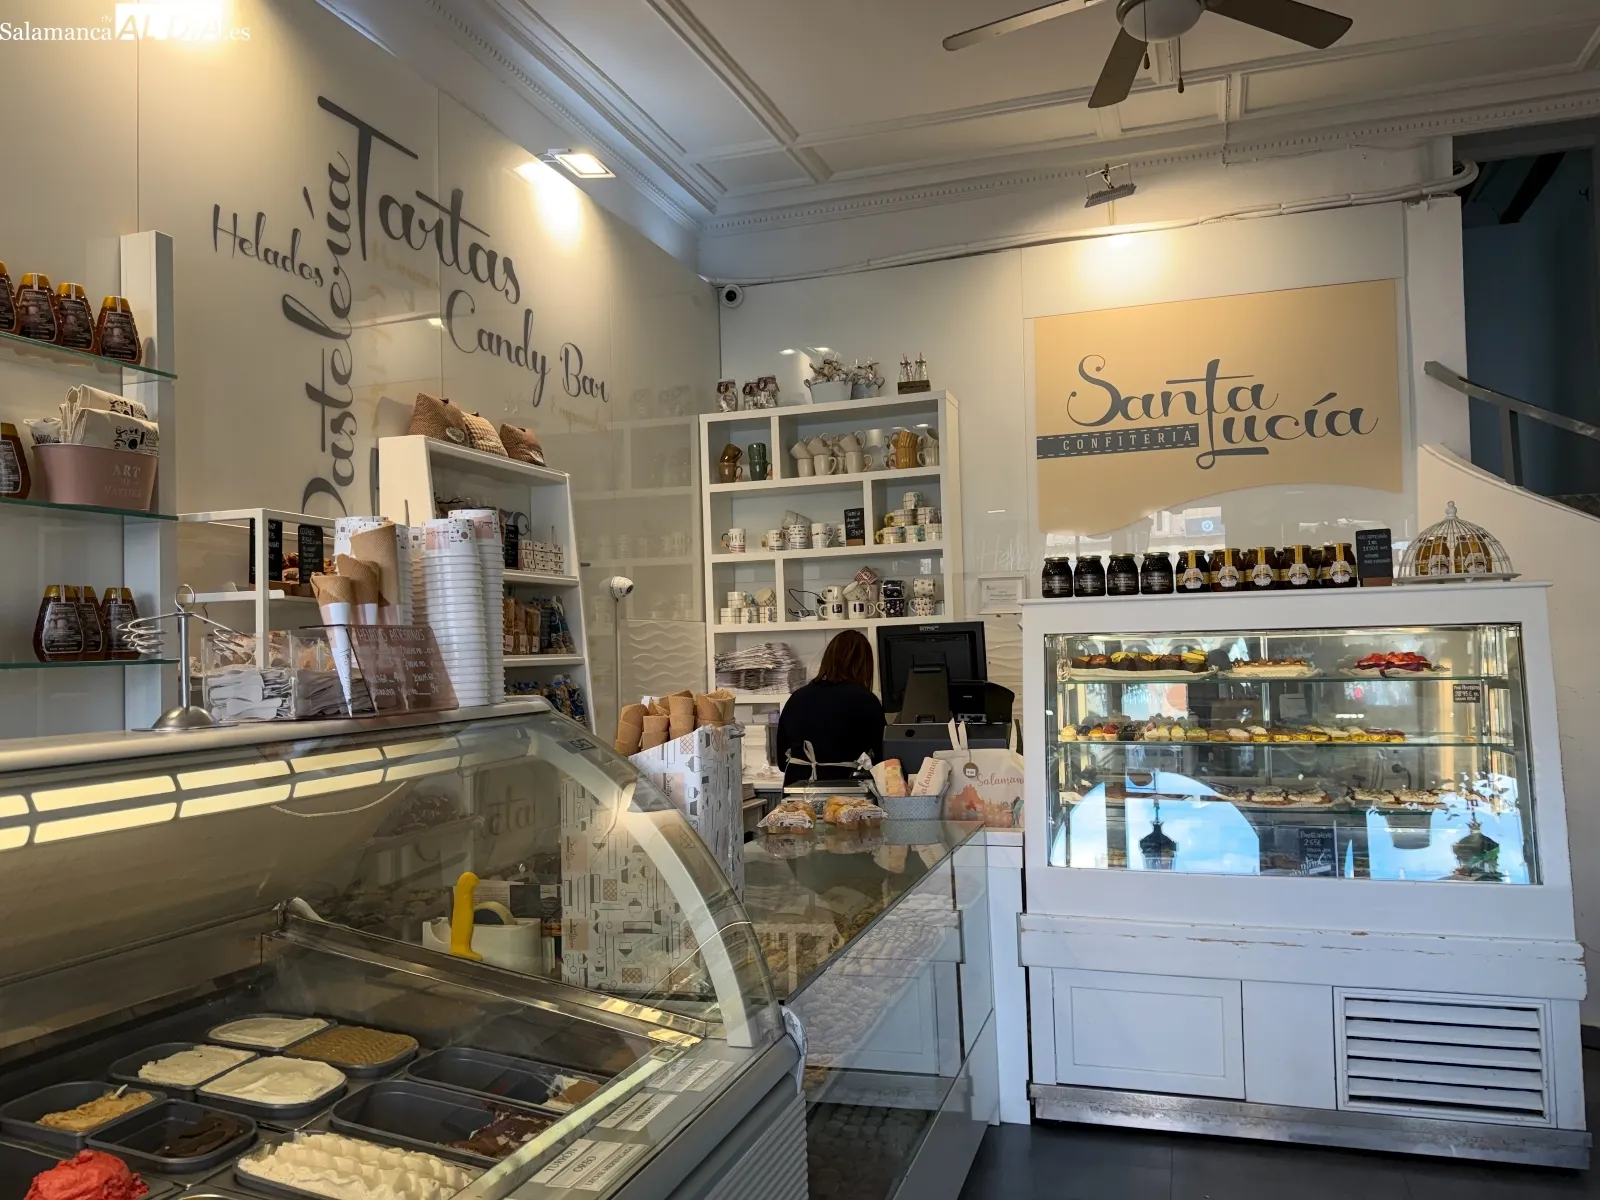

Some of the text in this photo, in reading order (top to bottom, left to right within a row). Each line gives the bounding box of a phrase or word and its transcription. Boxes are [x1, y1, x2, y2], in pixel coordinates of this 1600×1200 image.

[317, 95, 521, 304] Tartas
[213, 203, 324, 287] Helados
[445, 288, 610, 408] Candy Bar
[1066, 353, 1379, 470] Santa Lucía
[1062, 430, 1193, 451] CONFITERIA
[112, 464, 141, 479] ART
[543, 1147, 578, 1172] TURRÓN
[572, 1155, 597, 1173] OREO
